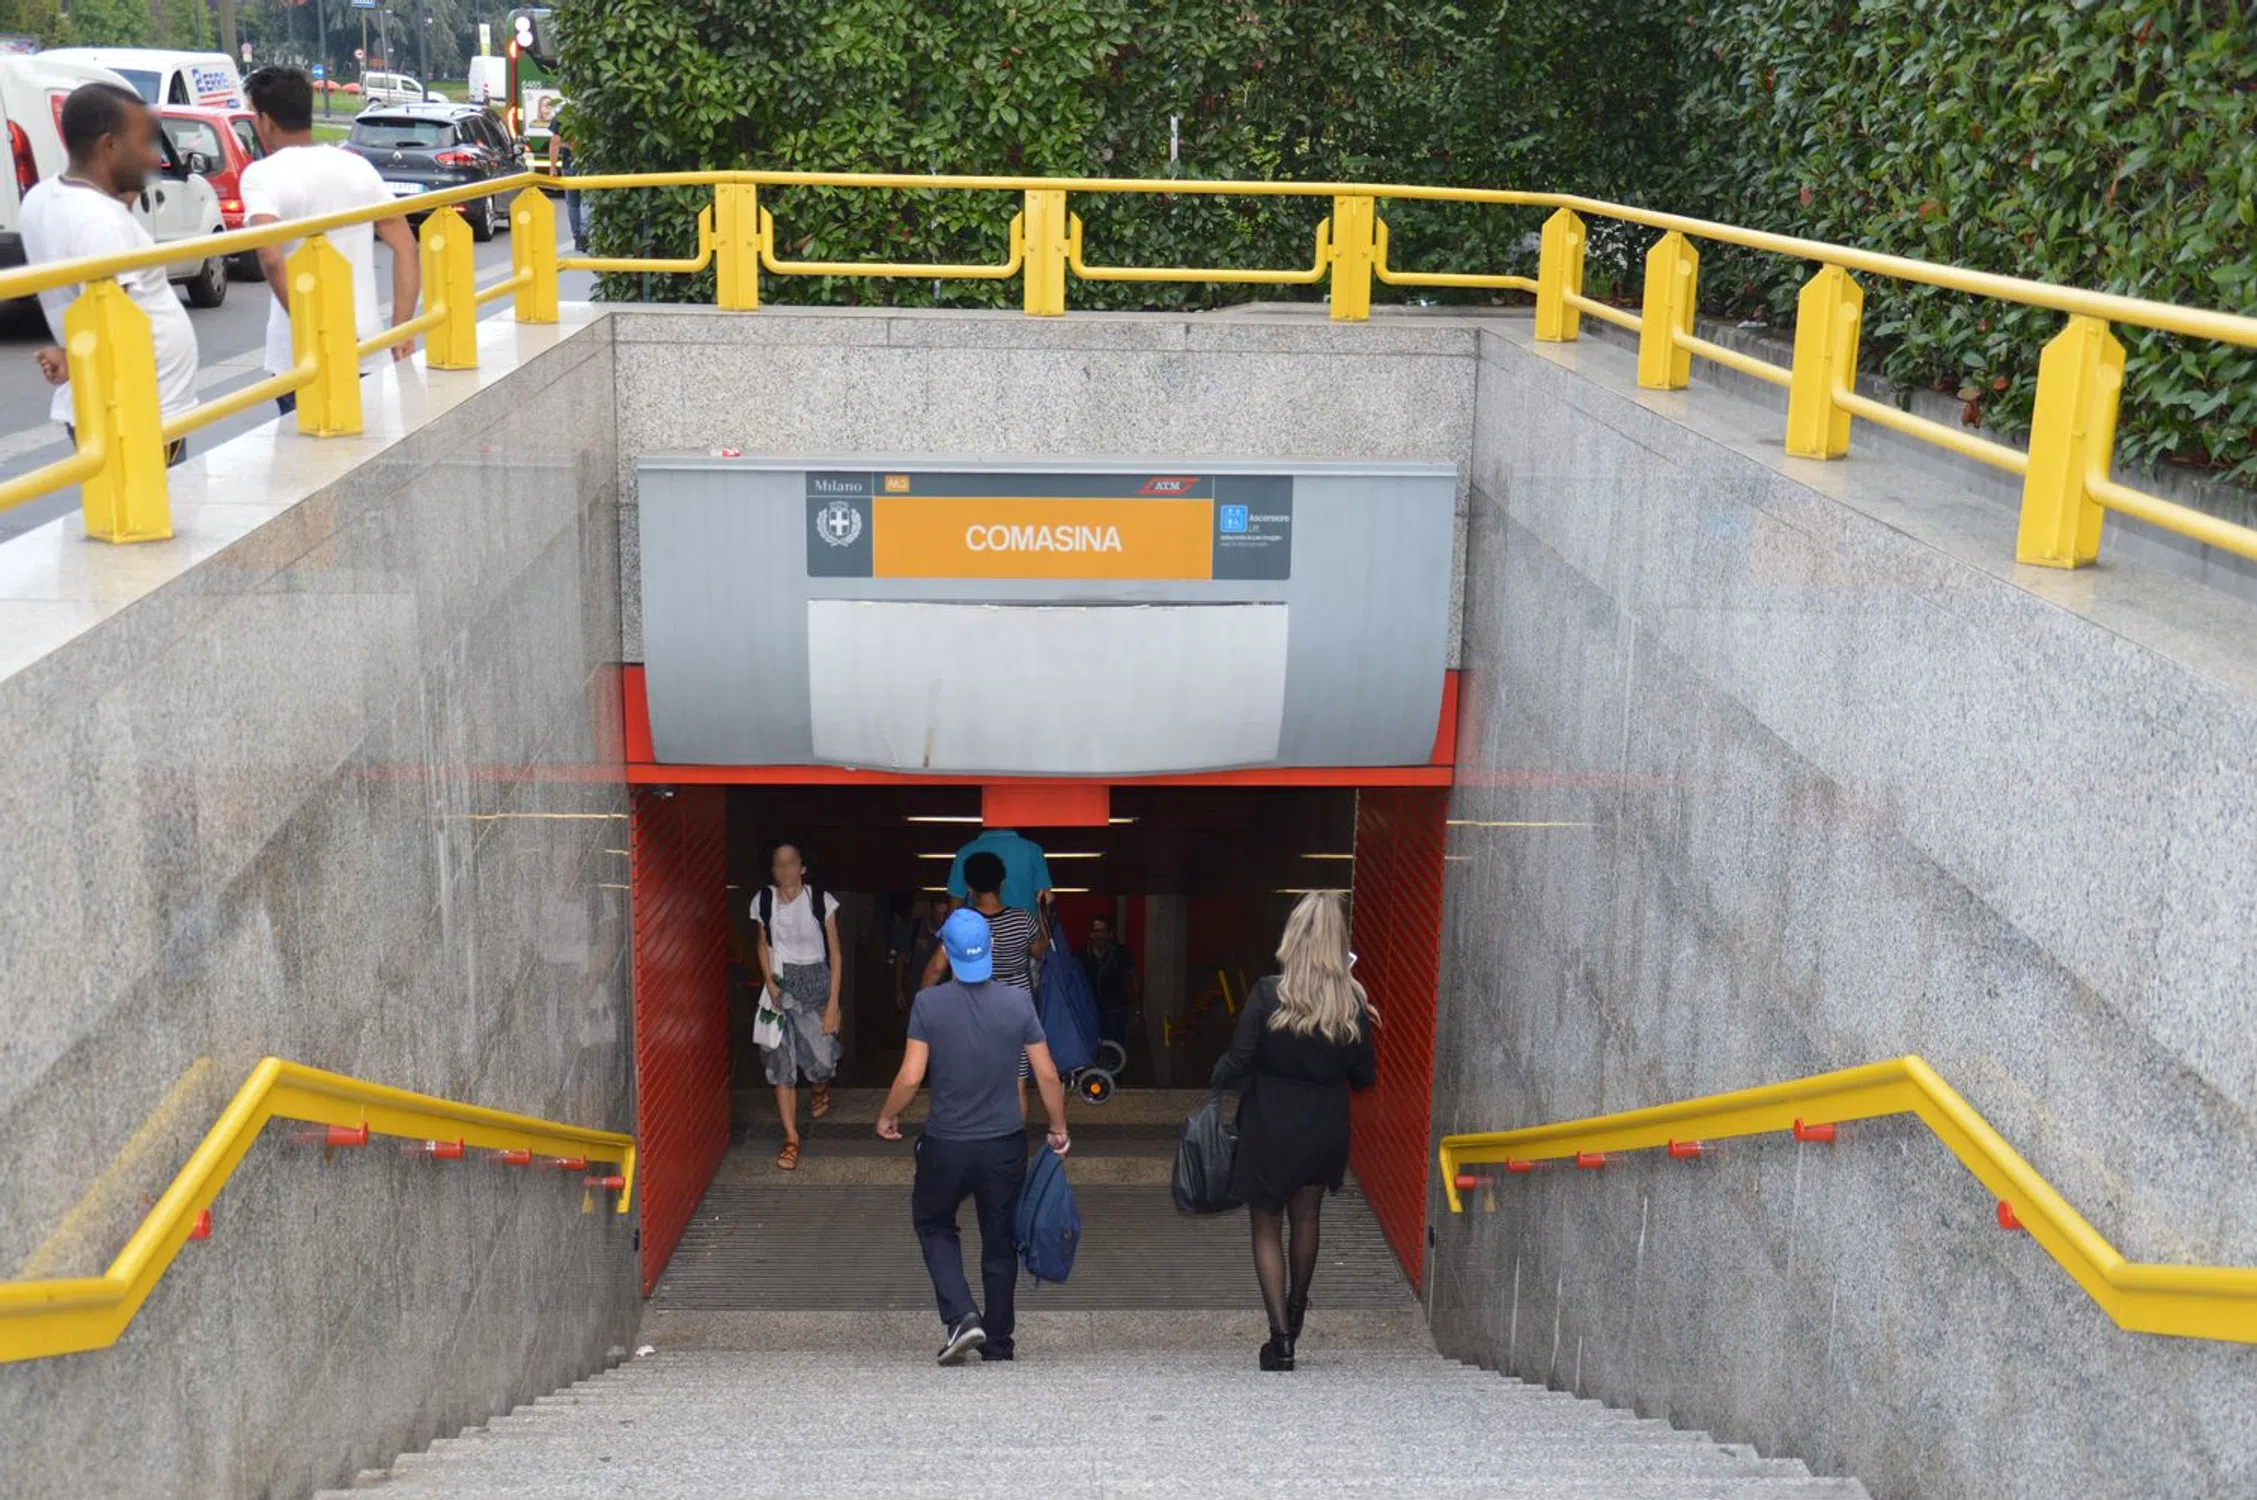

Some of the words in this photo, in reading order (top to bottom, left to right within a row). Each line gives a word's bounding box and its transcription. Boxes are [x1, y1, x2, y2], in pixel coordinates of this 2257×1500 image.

[814, 480, 862, 493] Milano
[1155, 481, 1180, 490] ATM
[965, 524, 1123, 553] COMASINA
